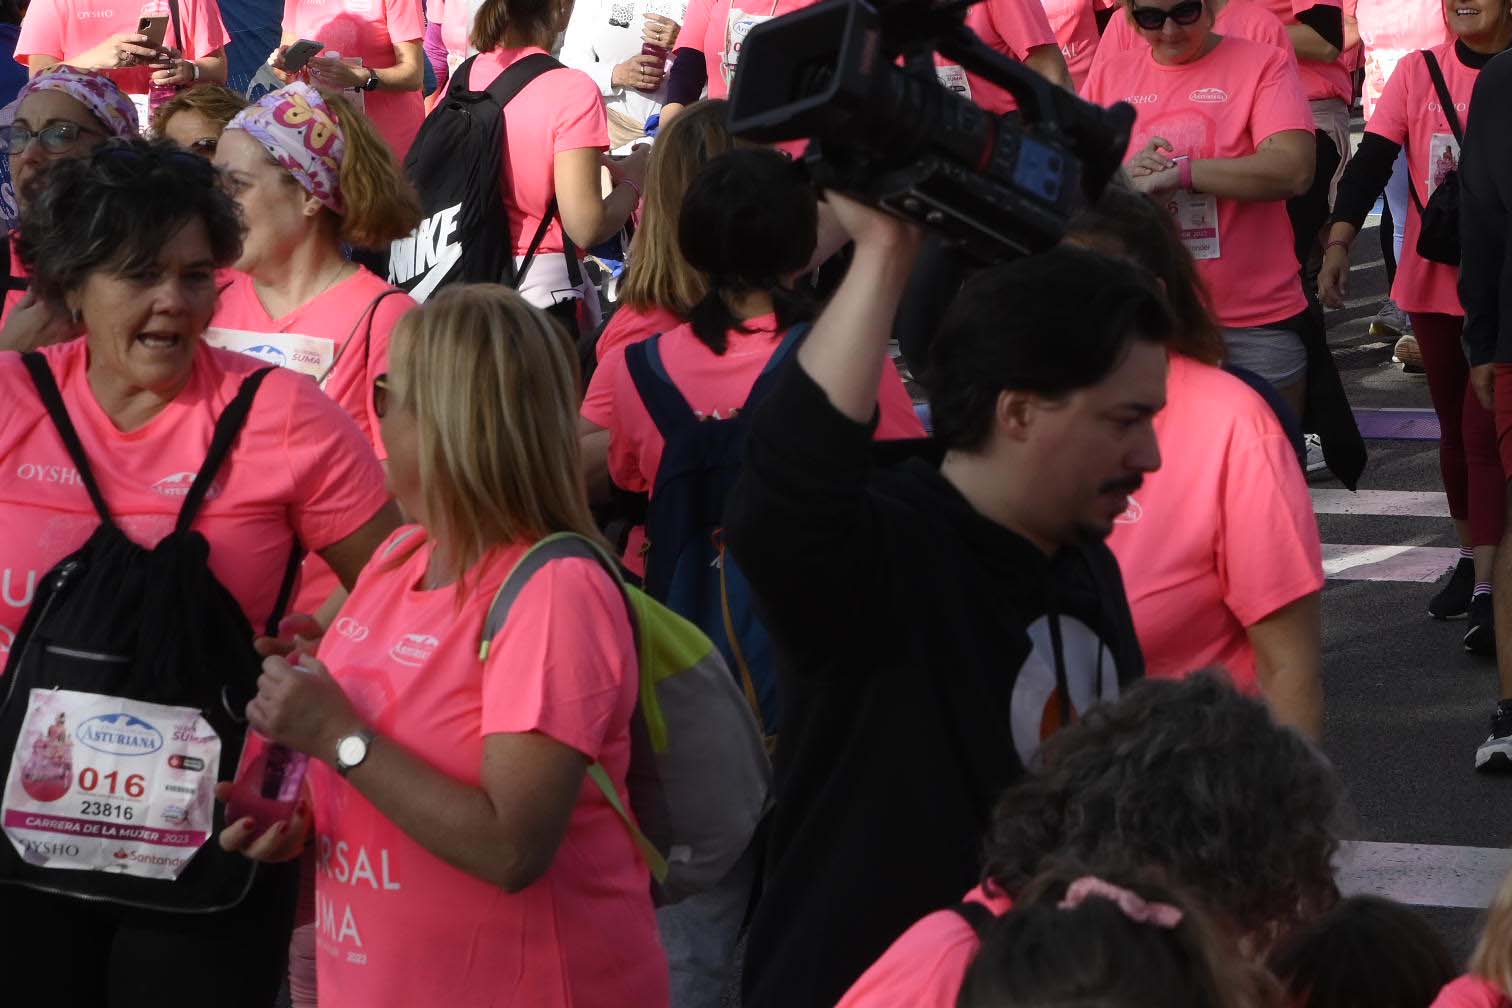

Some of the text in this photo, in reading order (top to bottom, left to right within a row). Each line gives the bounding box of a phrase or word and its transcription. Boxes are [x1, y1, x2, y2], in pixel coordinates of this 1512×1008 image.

[387, 202, 463, 286] NIKE
[292, 353, 321, 365] SUMA
[84, 726, 155, 750] ASTURIANA
[79, 766, 145, 799] 016
[80, 800, 133, 821] 23816
[25, 816, 82, 833] CARRERA
[83, 824, 101, 834] DE
[101, 826, 117, 836] LA
[119, 827, 160, 841] MUJER
